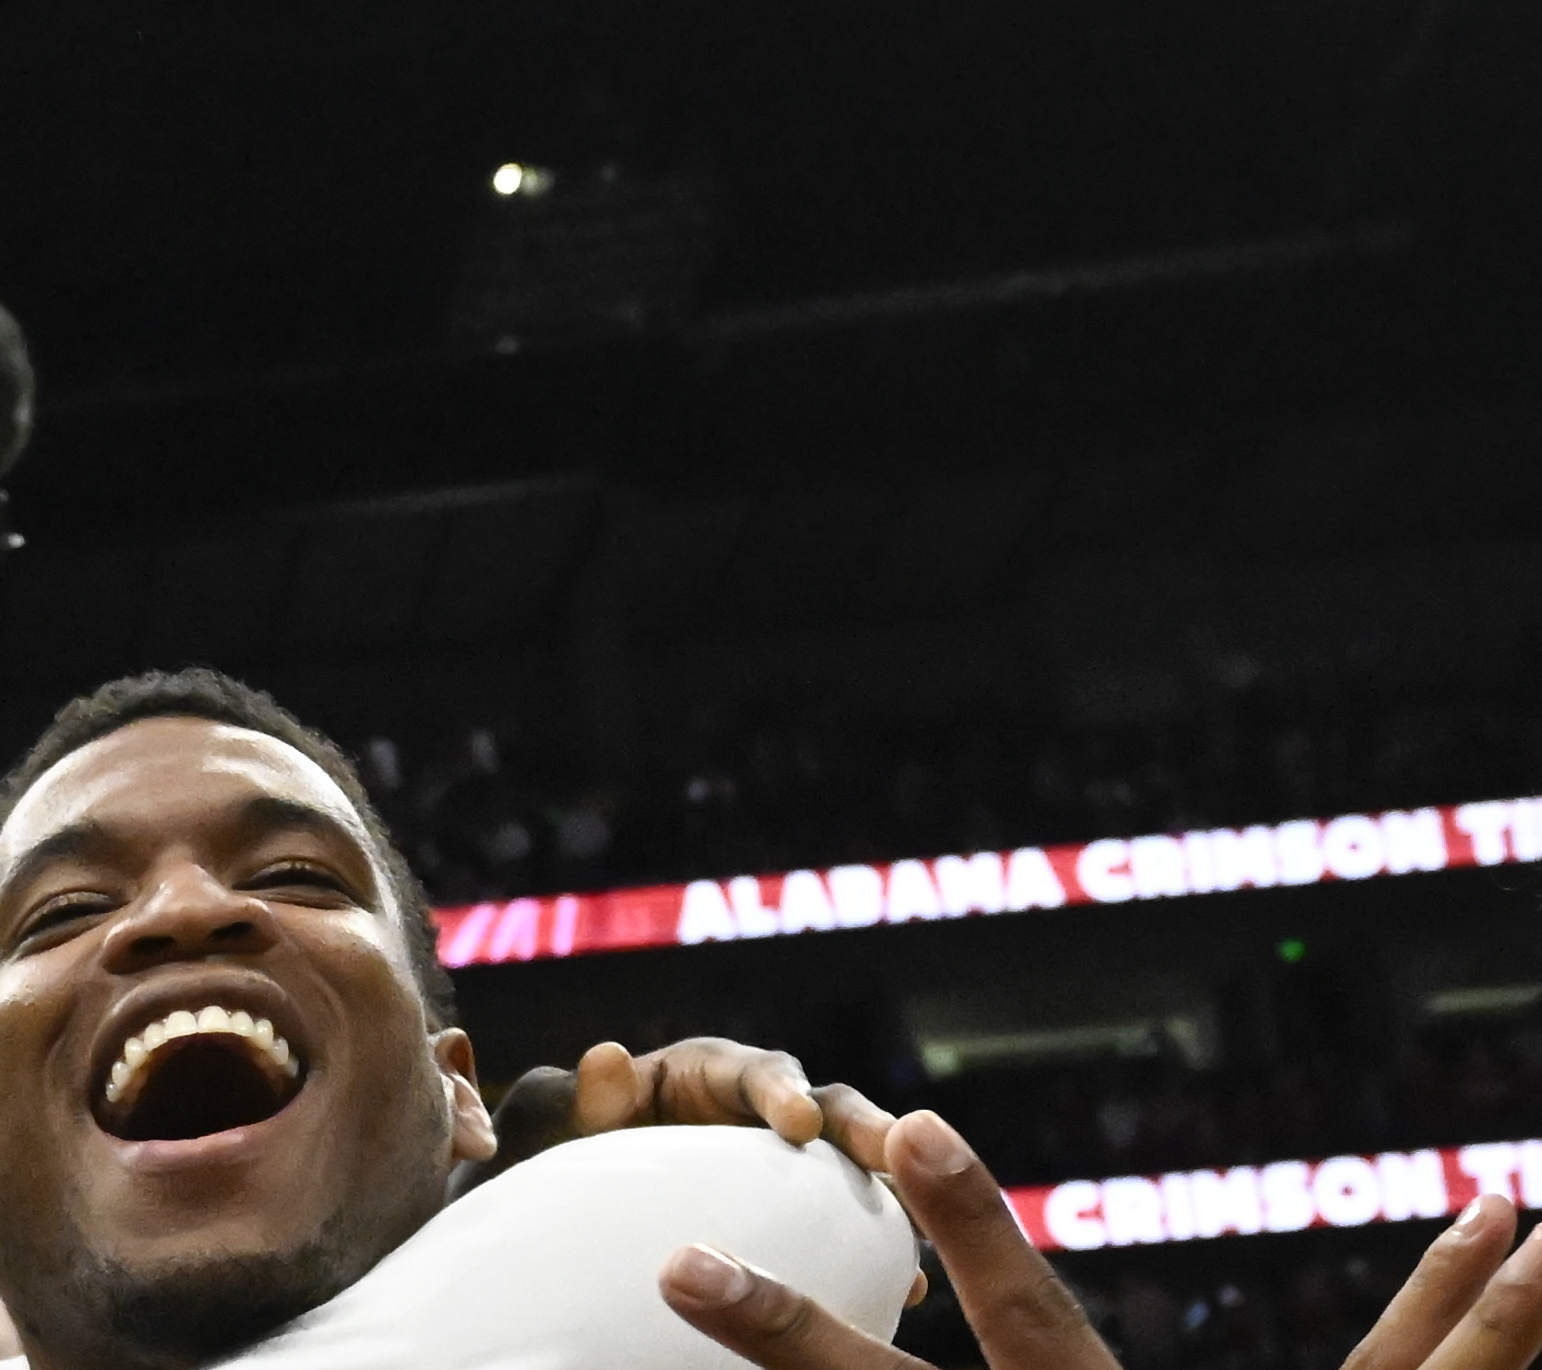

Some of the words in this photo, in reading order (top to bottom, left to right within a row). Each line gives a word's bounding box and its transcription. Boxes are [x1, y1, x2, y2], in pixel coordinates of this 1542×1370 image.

[675, 846, 1066, 946] ALABAMA
[1075, 806, 1449, 904] CRIMSON
[1044, 1148, 1449, 1251] CRIMSON
